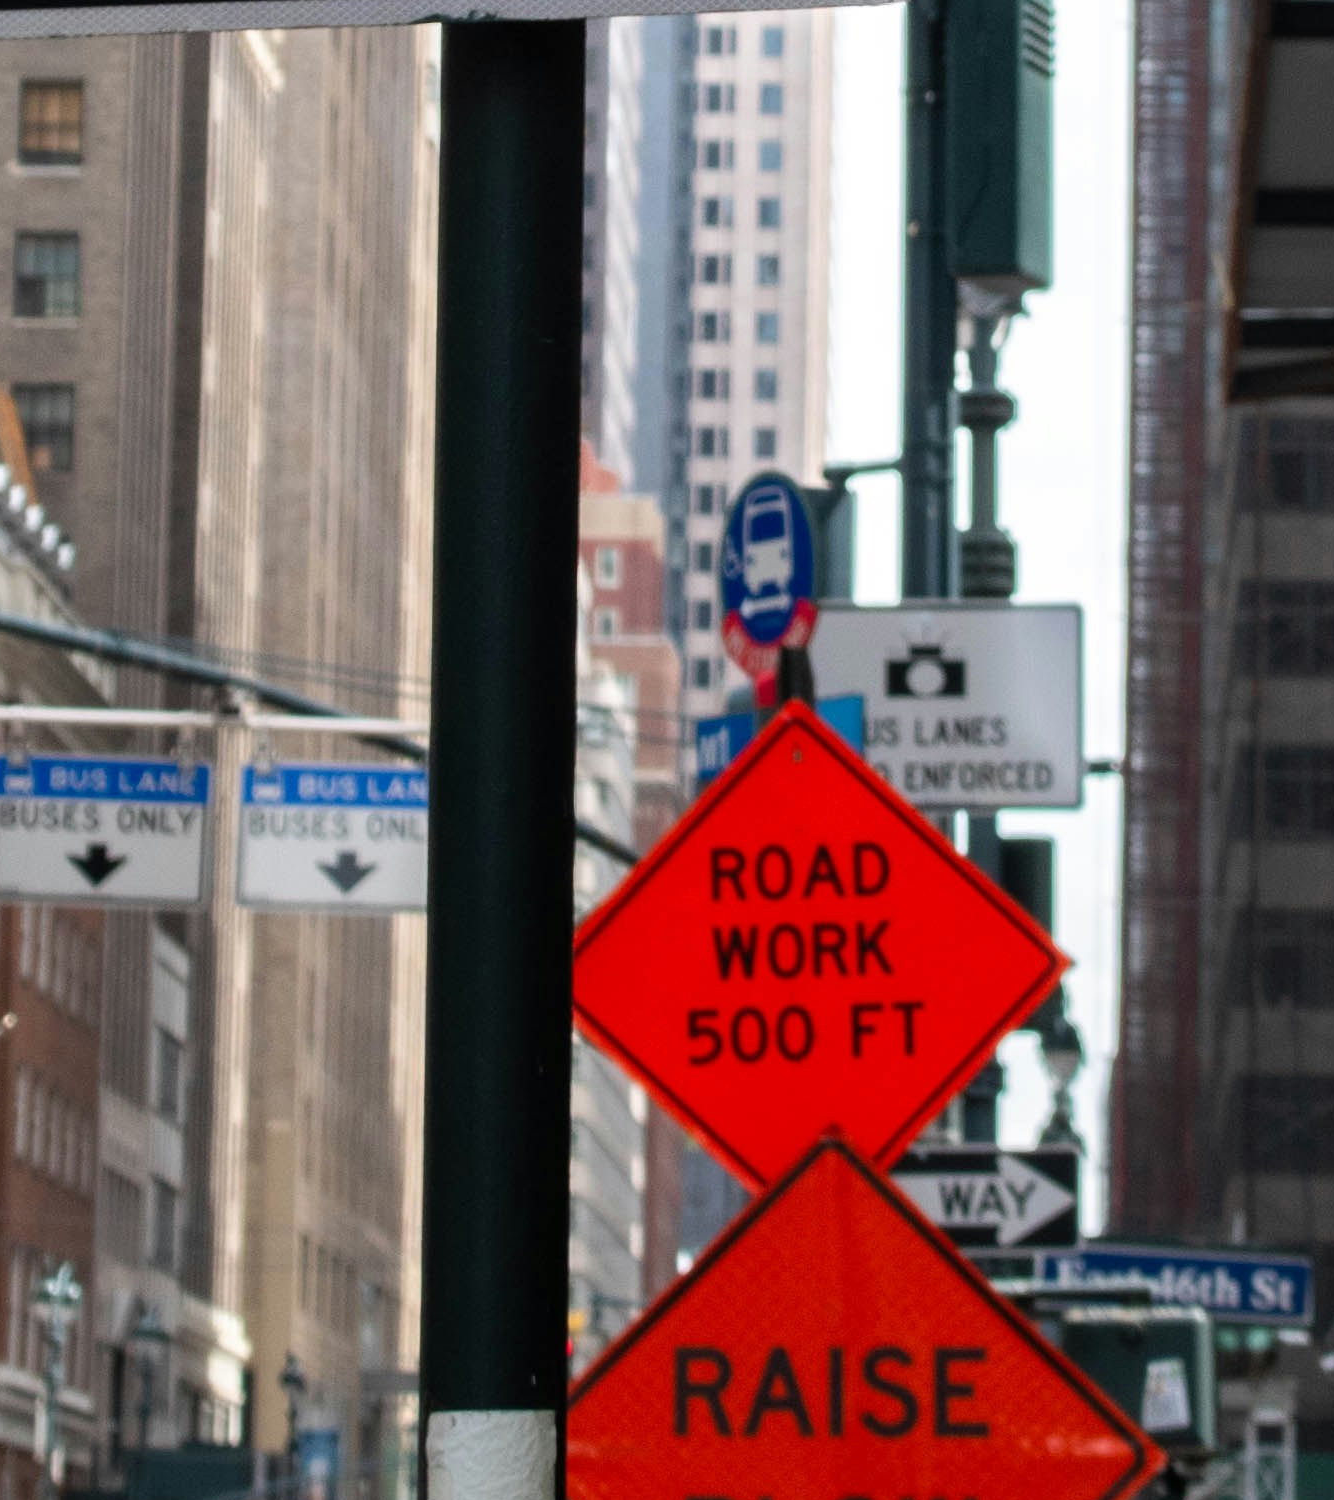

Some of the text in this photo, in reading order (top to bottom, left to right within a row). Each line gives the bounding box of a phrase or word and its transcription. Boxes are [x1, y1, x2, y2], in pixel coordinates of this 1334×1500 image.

[914, 716, 1010, 748] LANES
[49, 766, 197, 798] BUS LANE
[298, 769, 428, 801] BUS LAN
[904, 760, 1054, 793] ENFORCED
[116, 808, 198, 836] ONLY
[247, 811, 428, 843] BUSES ONL
[709, 842, 891, 903] ROAD
[711, 920, 894, 981] WORK
[686, 1000, 926, 1066] 500 FT
[936, 1178, 1037, 1221] WAY
[1250, 1265, 1296, 1312] St
[672, 1345, 992, 1439] RAISE
